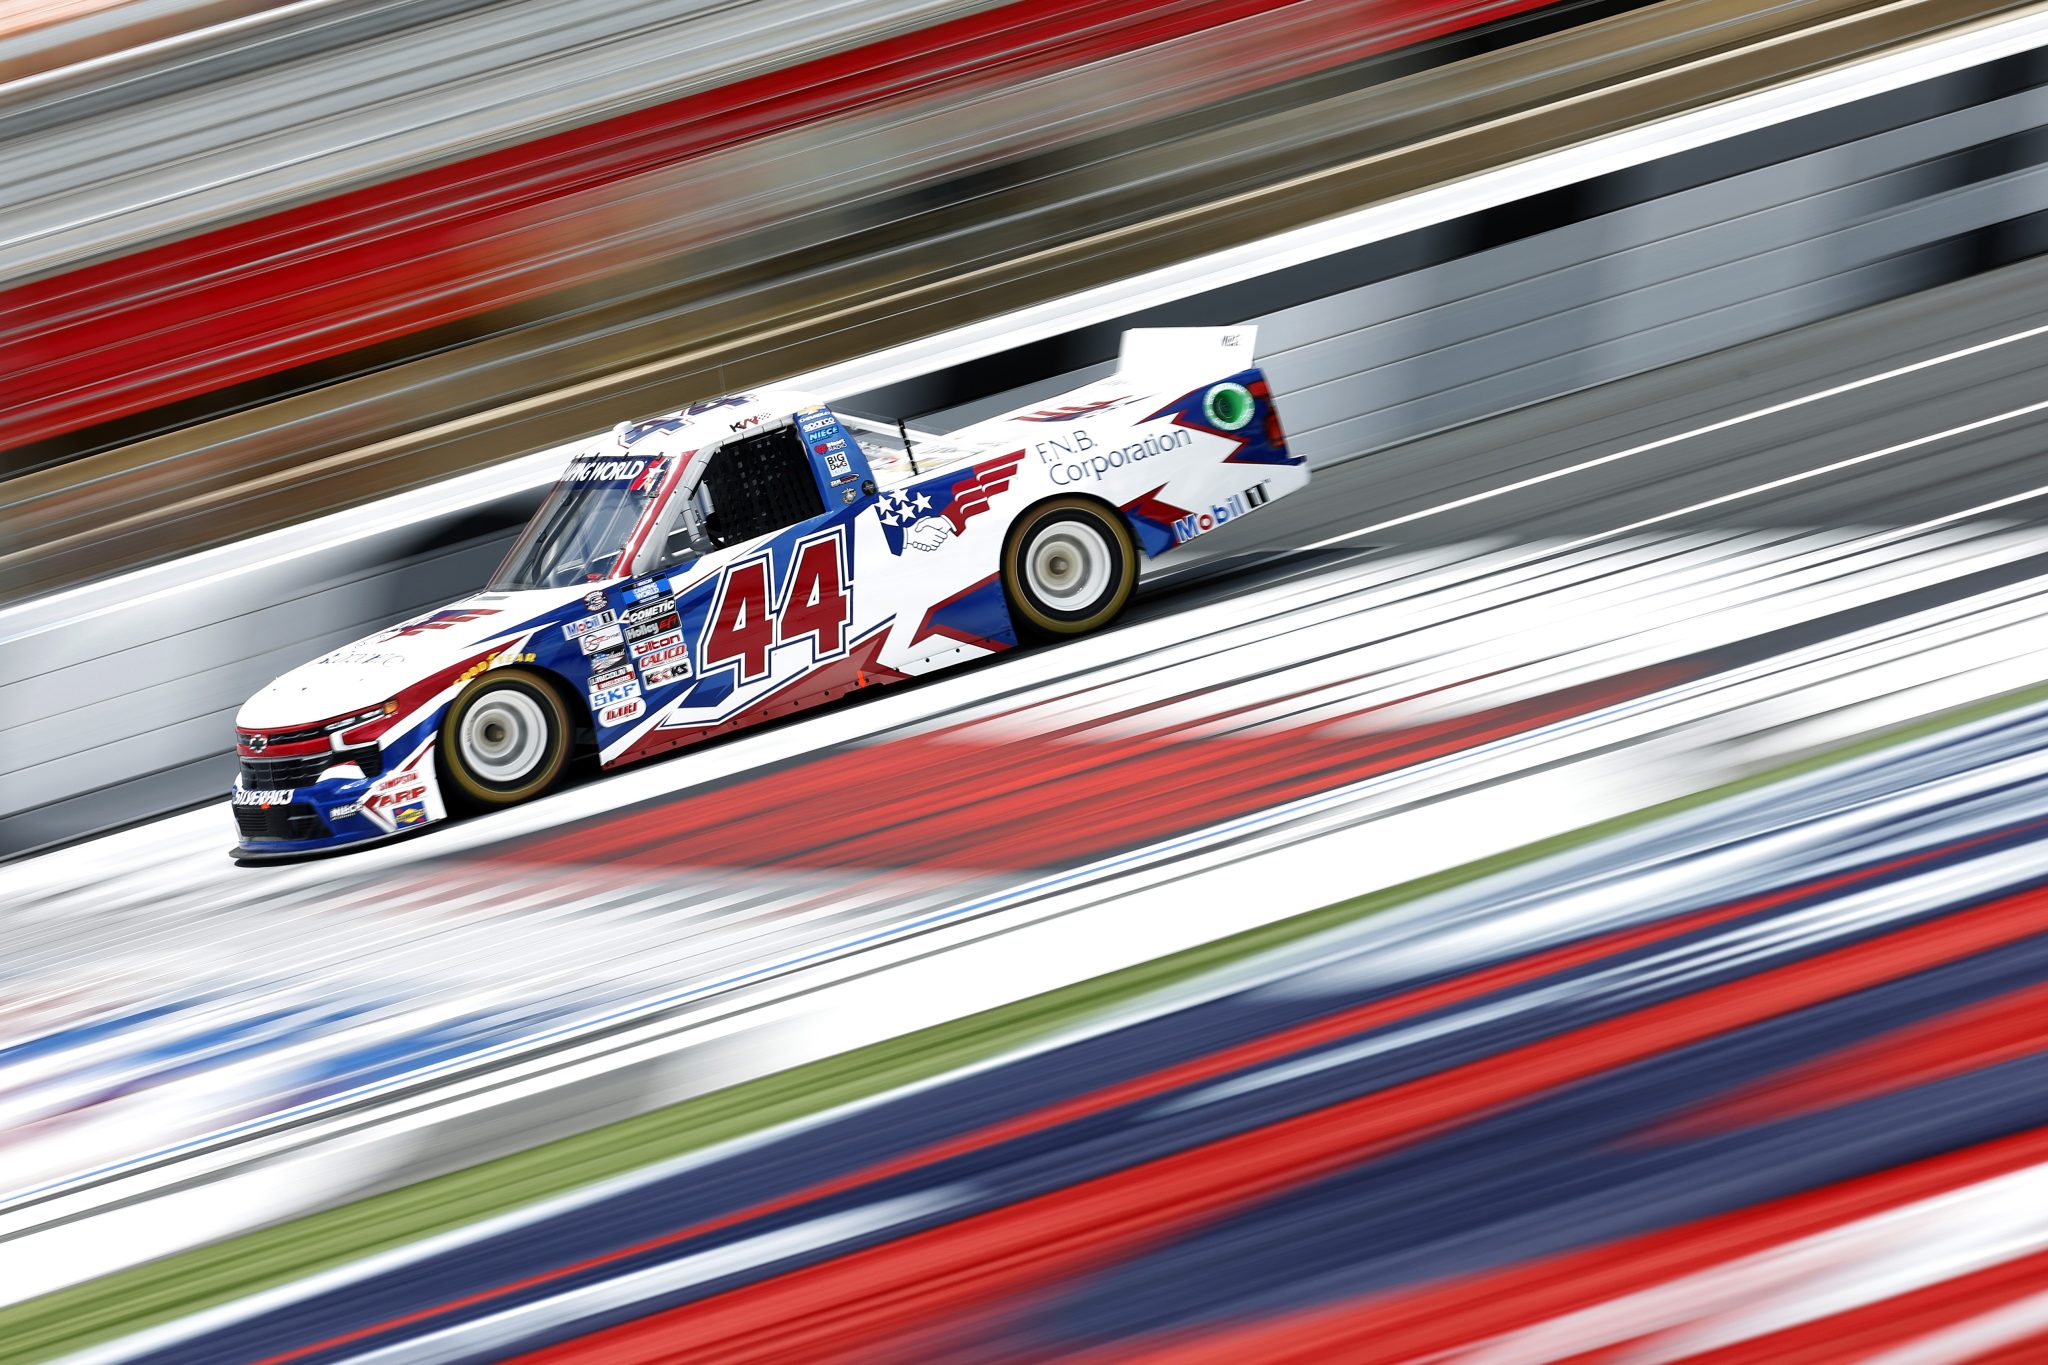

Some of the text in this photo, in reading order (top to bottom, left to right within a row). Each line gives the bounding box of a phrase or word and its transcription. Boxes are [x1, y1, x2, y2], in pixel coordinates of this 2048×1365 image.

[827, 454, 845, 465] BIG
[1049, 428, 1193, 487] Corporation
[592, 461, 645, 481] WORLD
[1173, 494, 1245, 543] Mobil
[630, 600, 675, 622] COMETIC
[700, 528, 854, 688] 44
[567, 617, 600, 635] Mobil
[627, 623, 659, 639] Holley
[635, 634, 680, 654] tilton
[641, 644, 686, 668] CALICO
[594, 683, 637, 708] SKF
[233, 789, 295, 806] SILVERADO
[378, 785, 427, 808] ARP
